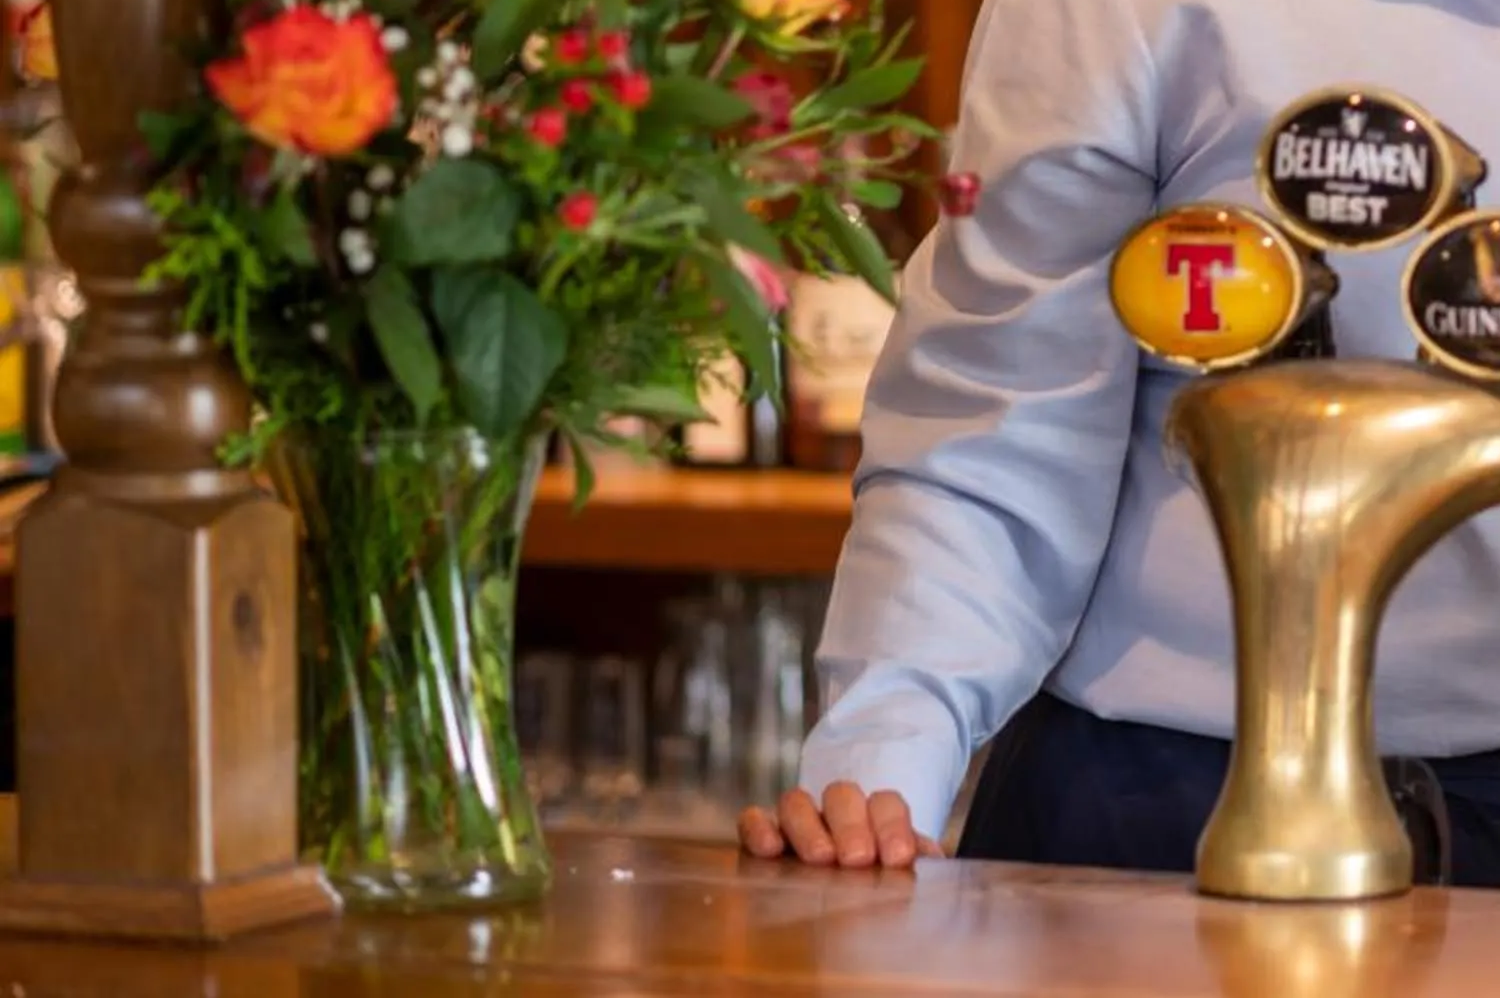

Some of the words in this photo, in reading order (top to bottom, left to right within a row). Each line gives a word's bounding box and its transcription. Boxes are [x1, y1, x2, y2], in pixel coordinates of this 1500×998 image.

[1274, 132, 1428, 191] BELHAVEN
[1306, 192, 1388, 224] BEST
[1167, 244, 1234, 330] T
